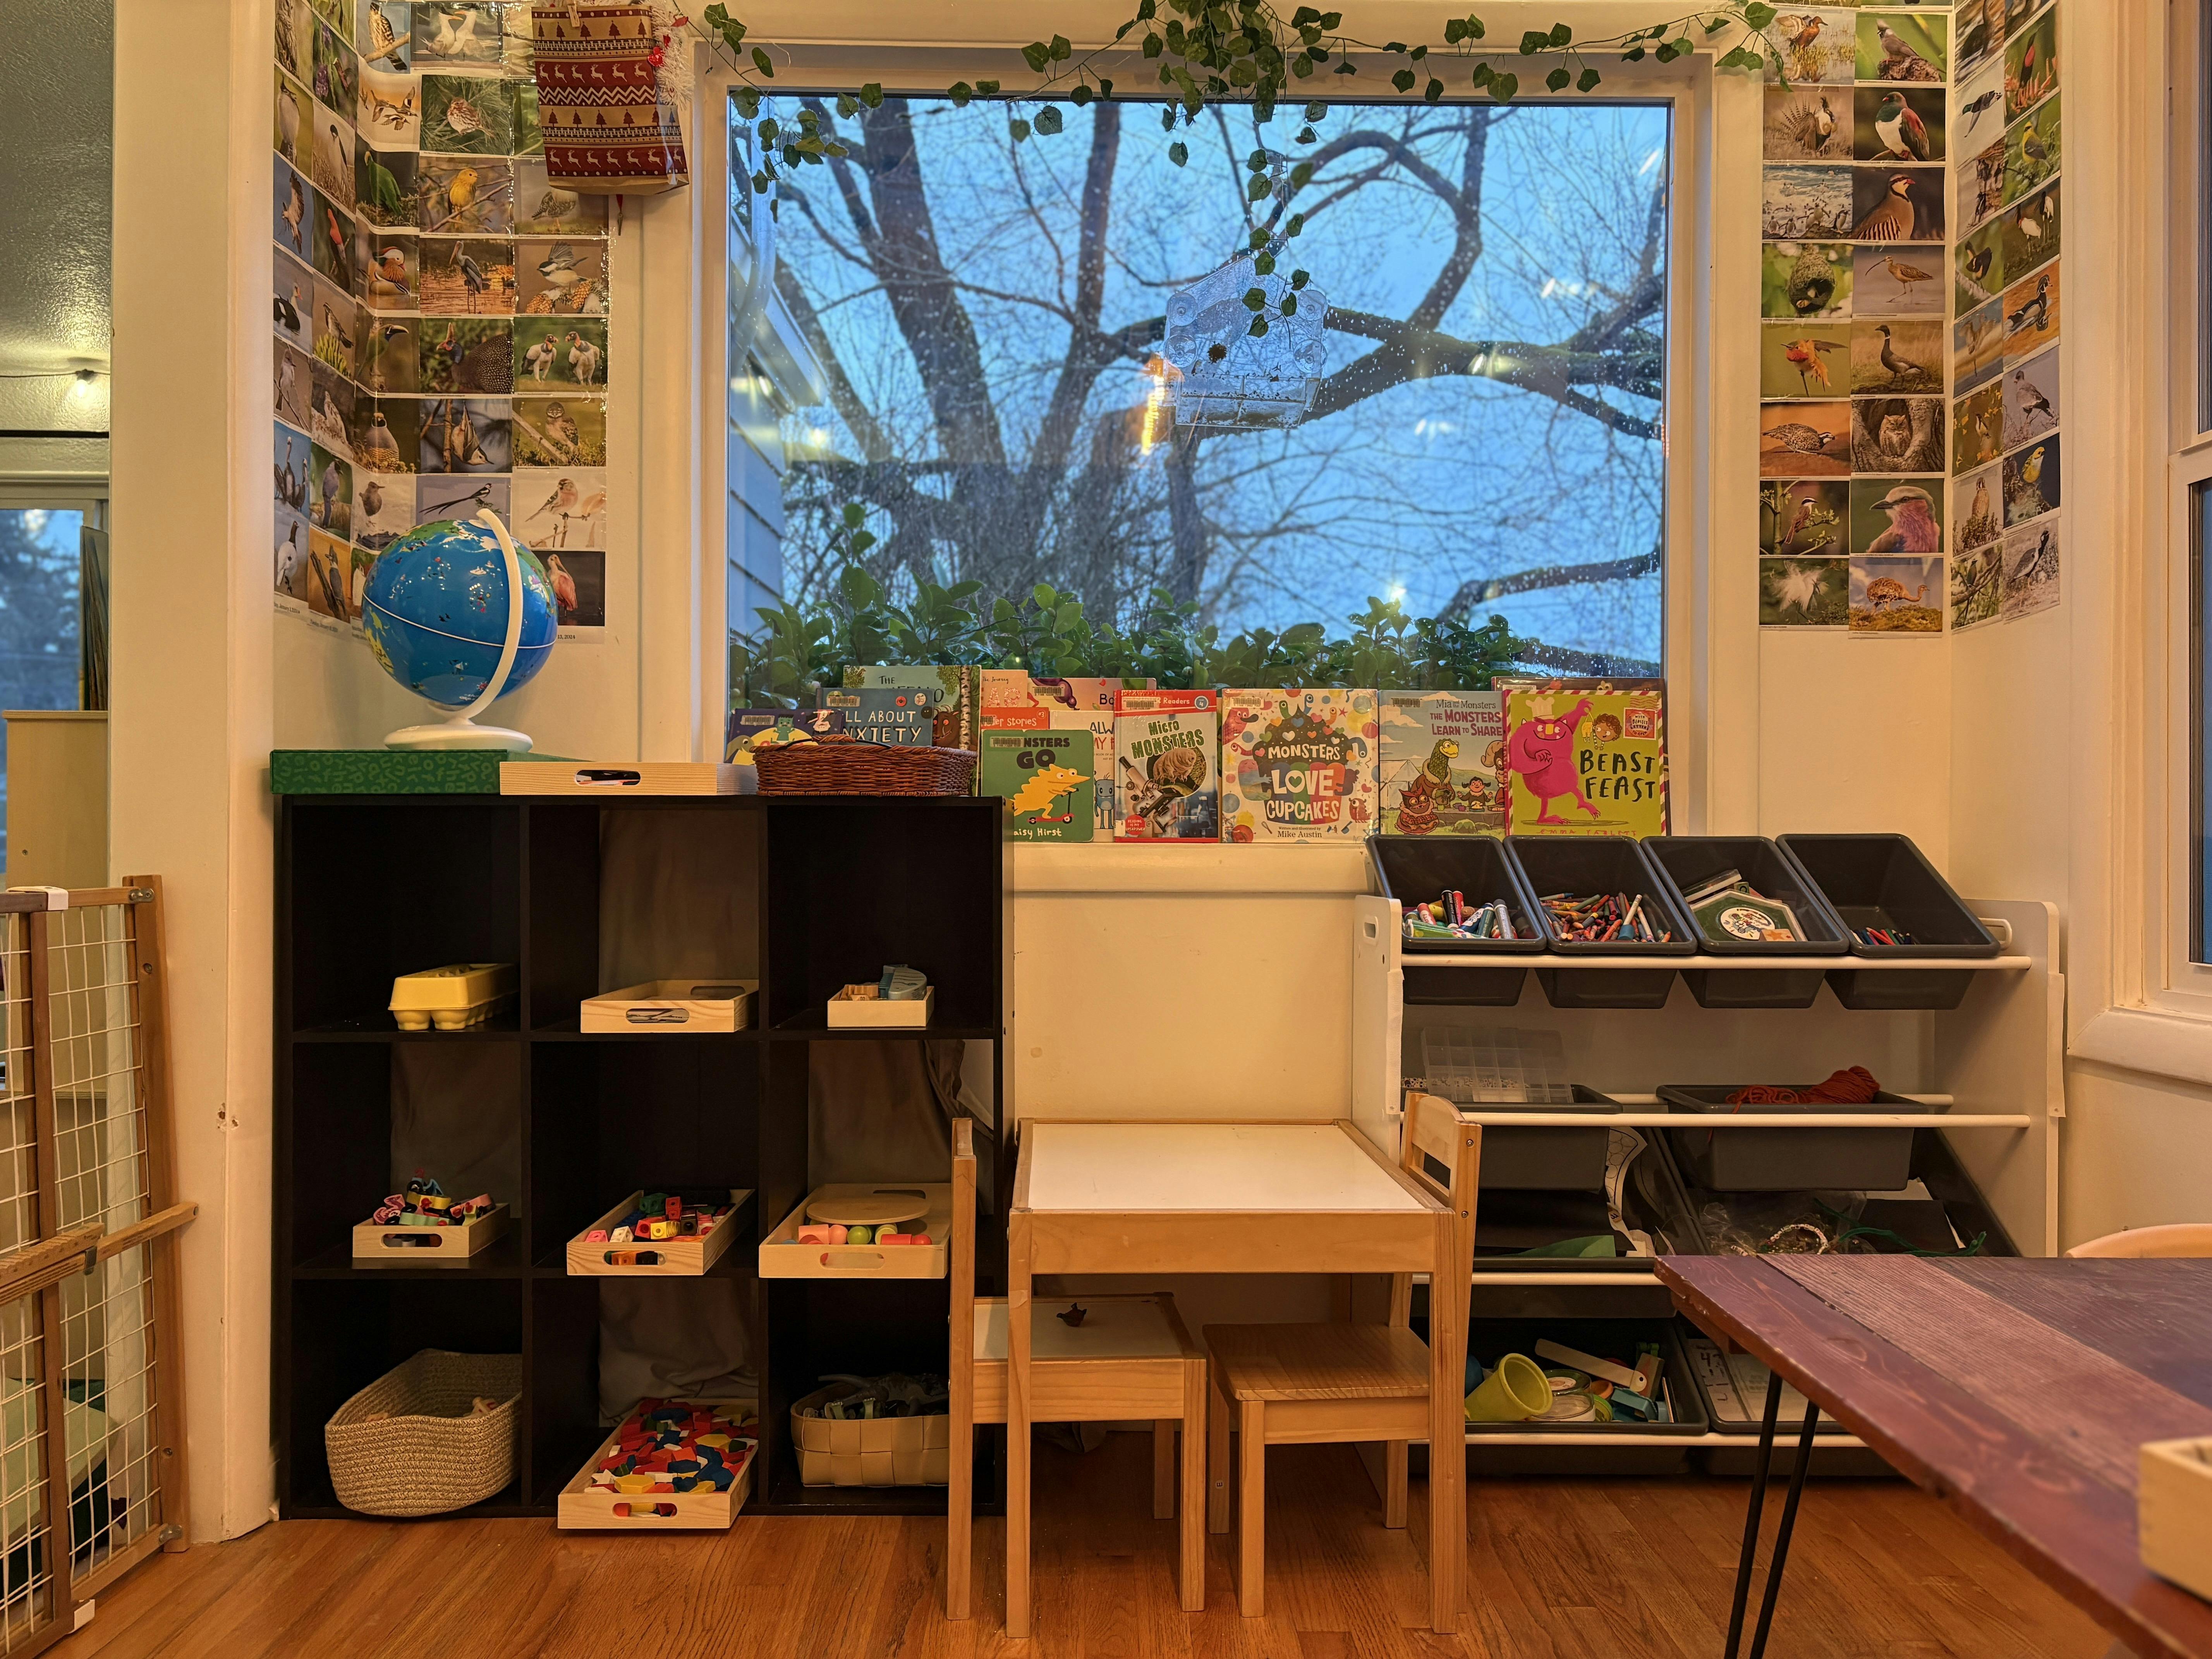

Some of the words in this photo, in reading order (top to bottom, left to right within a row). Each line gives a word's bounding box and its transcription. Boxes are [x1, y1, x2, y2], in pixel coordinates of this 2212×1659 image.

[878, 676, 895, 684] THE
[1436, 699, 1452, 708] Mia
[1461, 700, 1496, 709] Monsters
[845, 711, 861, 722] LL
[868, 711, 916, 723] ABOUT
[1007, 718, 1037, 726] Stories
[1444, 709, 1501, 723] MONSTERS
[843, 727, 922, 743] NXIETY
[1148, 720, 1180, 736] Micro
[1432, 723, 1461, 735] LEARN
[1470, 723, 1503, 736] SHARE
[1024, 737, 1070, 747] NSTERS
[1131, 729, 1204, 759] MONSTERS
[1017, 749, 1056, 769] GO
[1268, 744, 1341, 760] MONSTERS
[1580, 749, 1655, 775] BEAST
[1271, 769, 1334, 797] LOVE
[1585, 776, 1656, 802] FEAST
[1267, 800, 1340, 821] CUPCAKES
[1014, 829, 1033, 840] aisy
[1037, 828, 1062, 836] Hirst
